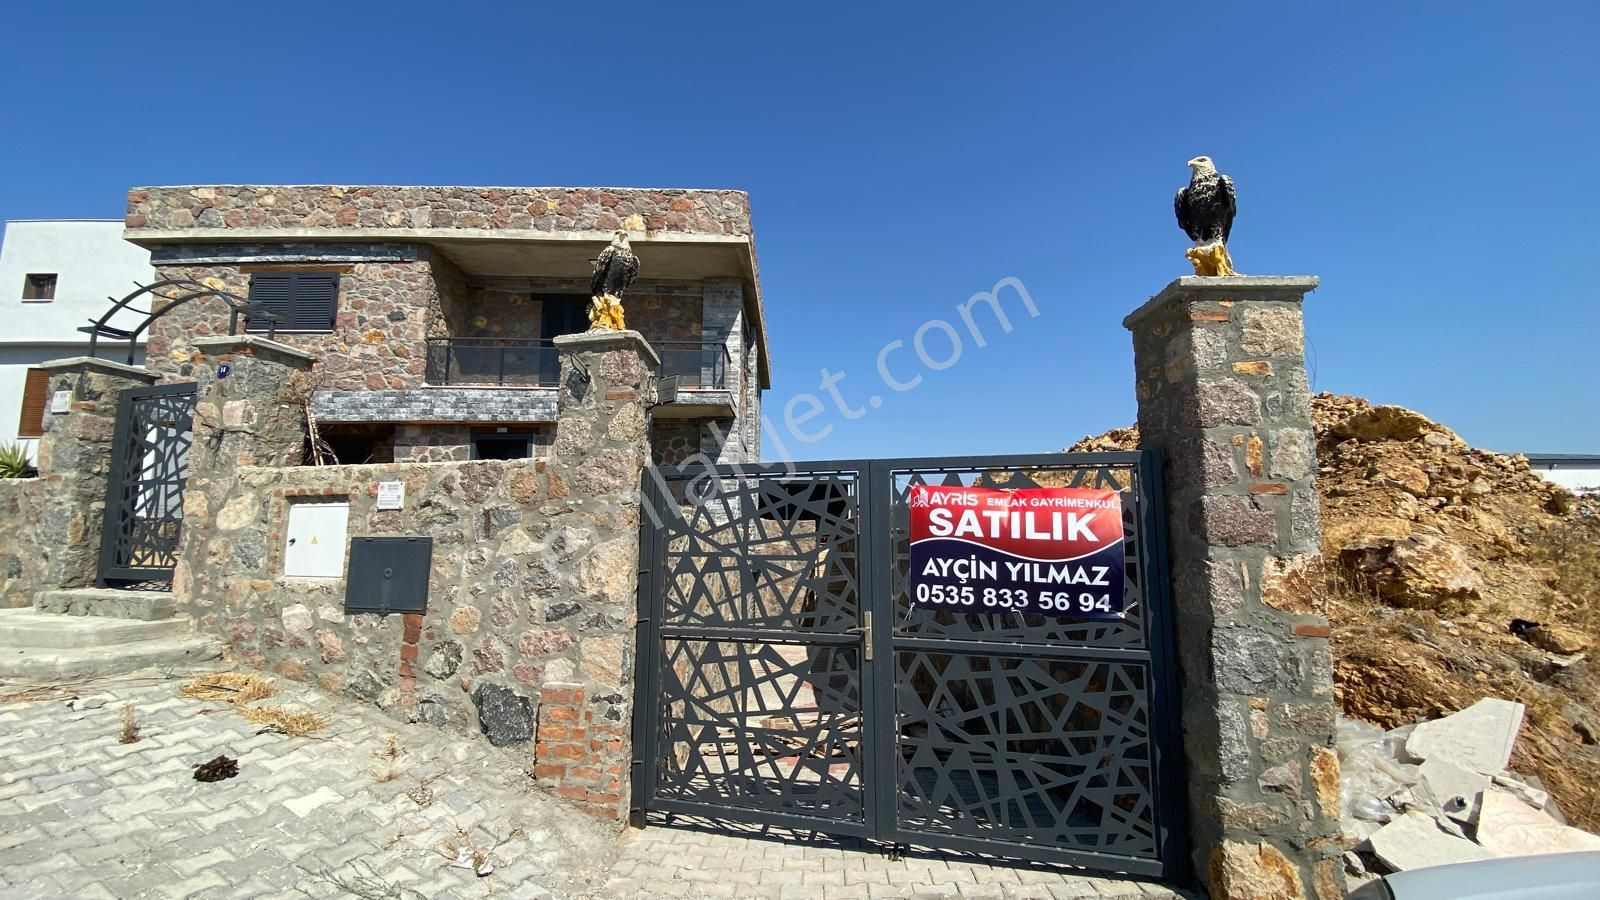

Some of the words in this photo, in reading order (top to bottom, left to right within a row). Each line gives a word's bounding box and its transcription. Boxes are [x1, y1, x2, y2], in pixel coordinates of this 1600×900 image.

[930, 491, 978, 507] AYRİS
[987, 497, 1027, 508] EMLAK
[1030, 496, 1118, 509] GAYRİMENKUL
[928, 509, 1099, 542] SATILIK
[922, 554, 998, 584] AYÇİN
[1005, 561, 1110, 586] YILMAZ
[916, 583, 974, 605] 0535
[983, 588, 1029, 608] 833
[1038, 591, 1070, 611] 56
[1079, 593, 1111, 613] 94
